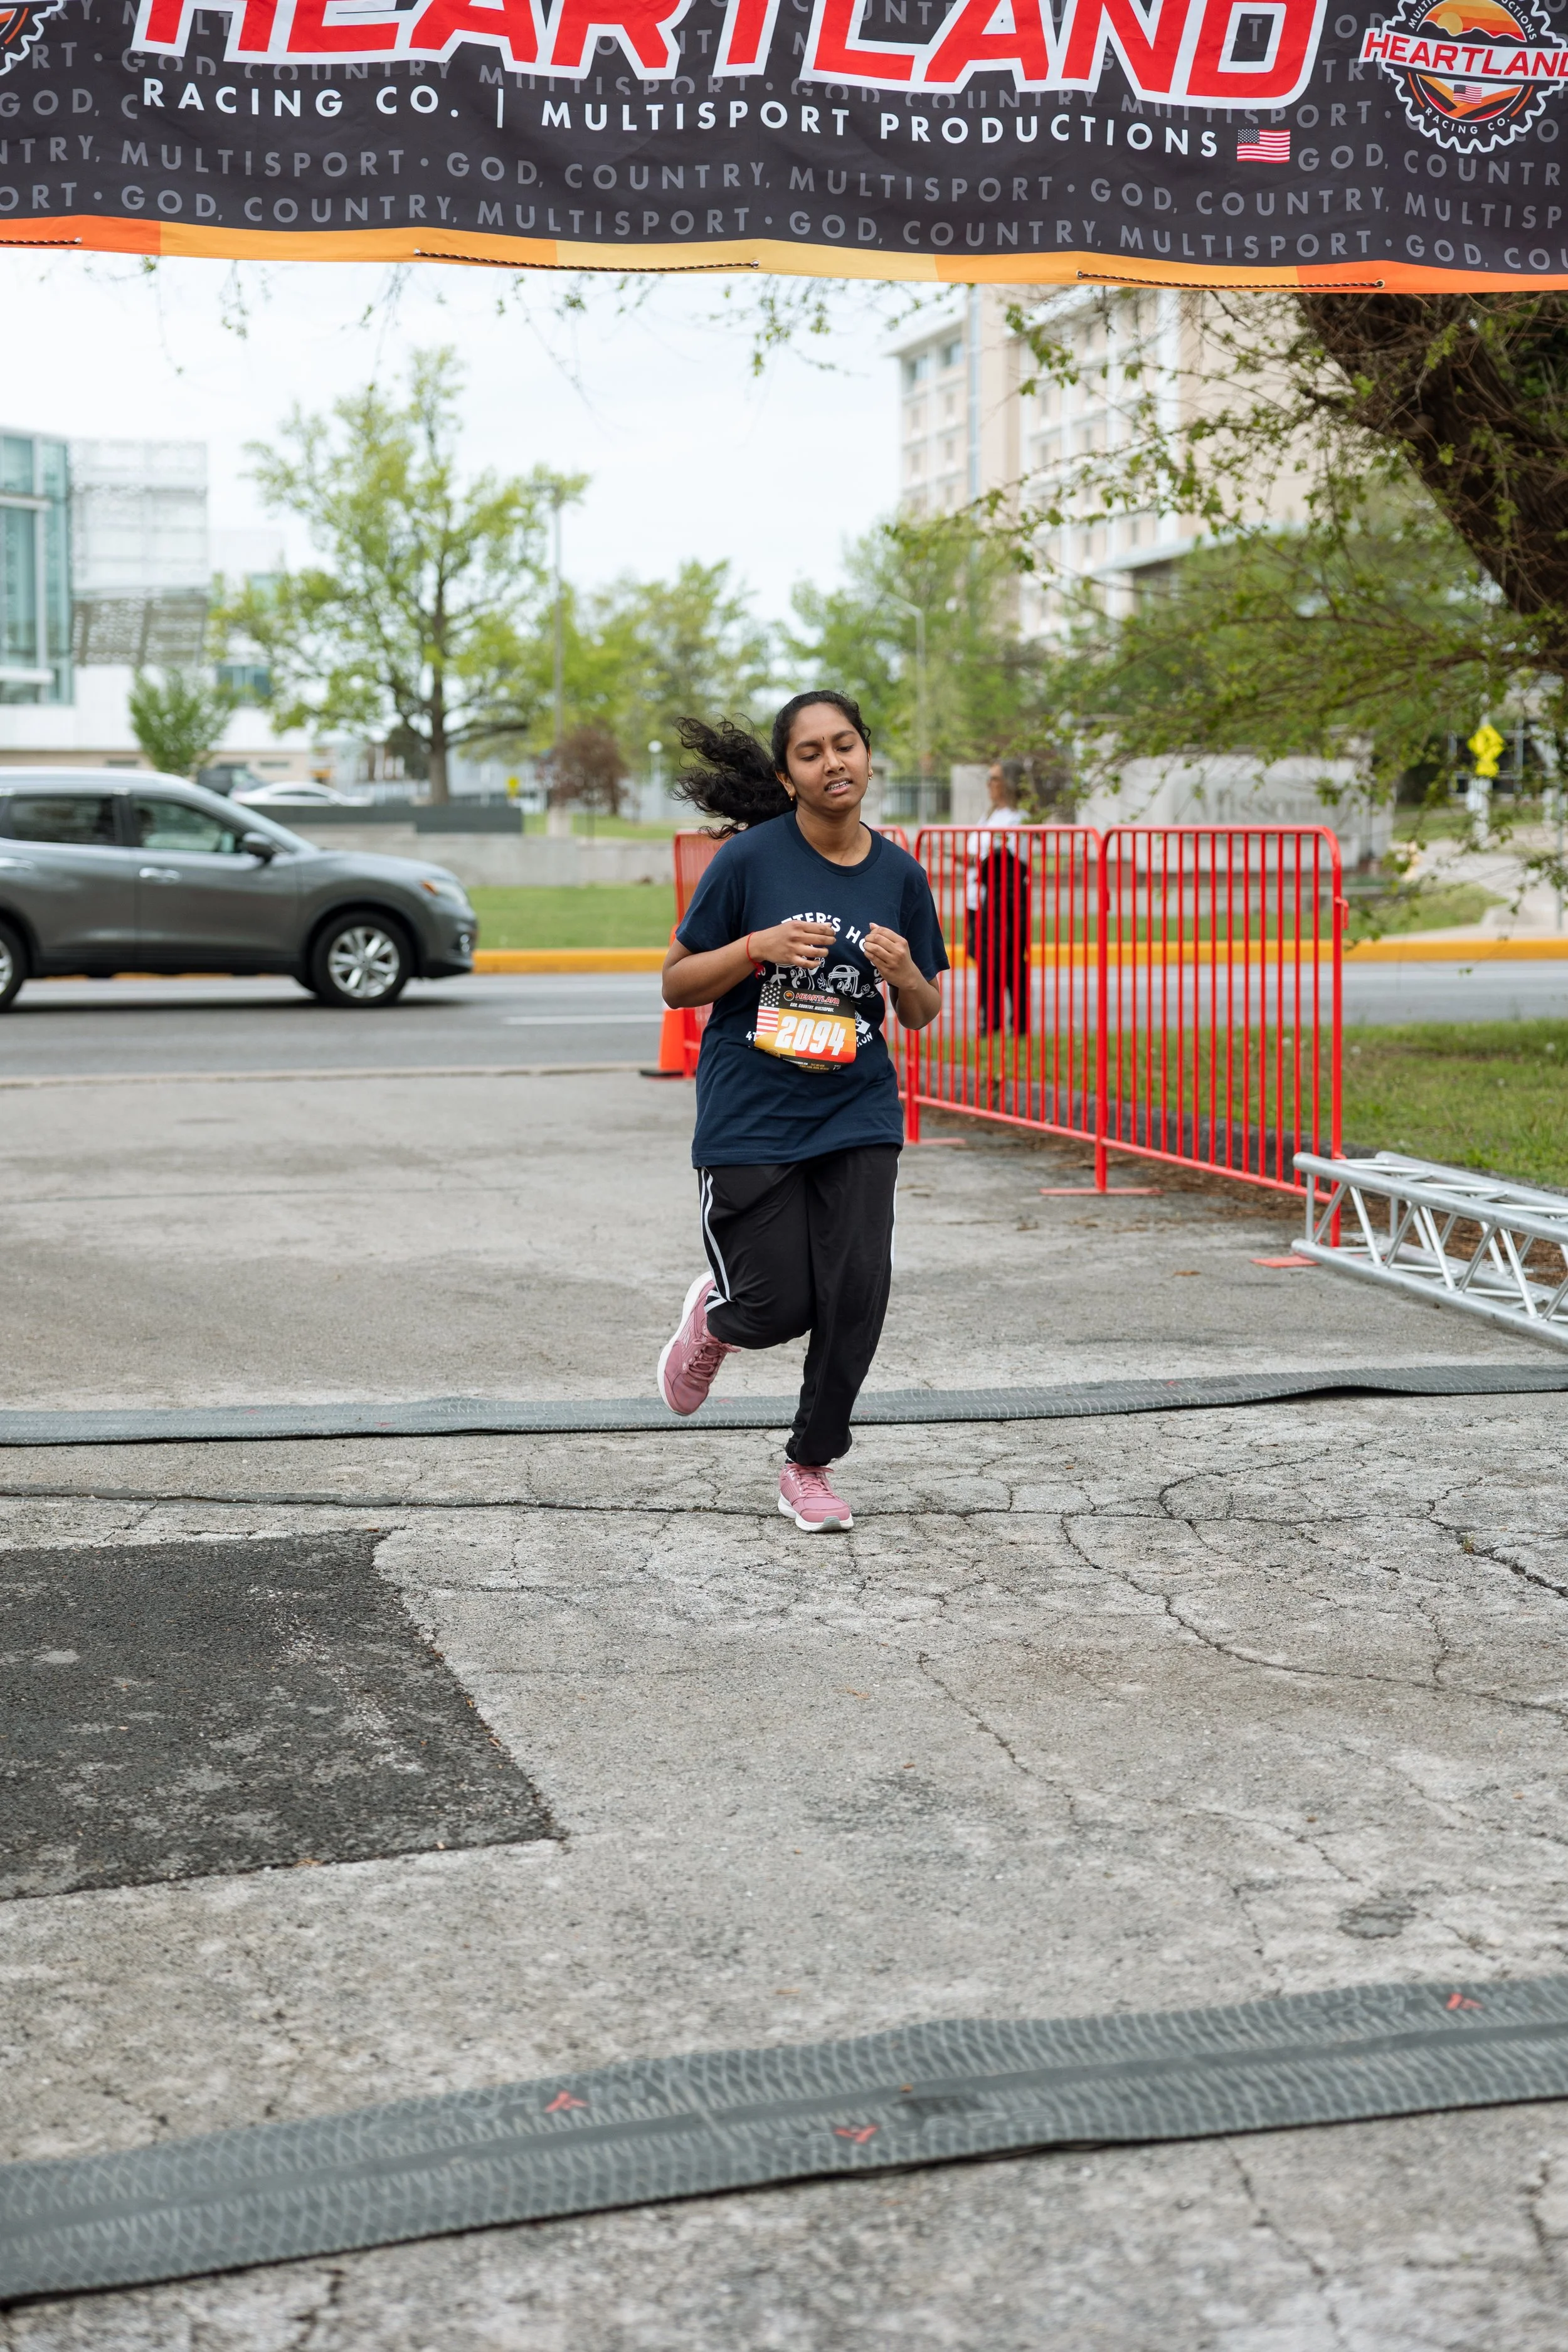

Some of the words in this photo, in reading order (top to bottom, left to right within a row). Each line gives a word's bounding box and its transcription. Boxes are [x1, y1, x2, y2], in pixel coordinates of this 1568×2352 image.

[144, 78, 342, 117] RACING
[376, 85, 458, 117] CO.
[542, 101, 849, 135] MULTISPORT
[881, 113, 1217, 157] PRODUCTIONS
[1426, 107, 1478, 135] RACING
[1488, 118, 1510, 131] CO.
[121, 140, 404, 176] MULTISPORT
[447, 152, 543, 188] GOD,
[565, 162, 770, 189] COUNTRY,
[790, 167, 1052, 201] MULTISPORT
[1091, 179, 1177, 213] GOD,
[1197, 187, 1389, 216] COUNTRY,
[1405, 193, 1561, 228] MULTISP
[1298, 144, 1388, 171] GOD,
[1404, 149, 1559, 185] COUNTR
[122, 189, 223, 220] GOD,
[244, 194, 457, 223] COUNTRY,
[477, 201, 749, 235] MULTISPORT
[790, 211, 882, 244] GOD,
[903, 220, 1101, 246] COUNTRY,
[1120, 225, 1370, 258] MULTISPORT
[1406, 235, 1488, 267] GOD,
[781, 912, 841, 933] ER'S
[795, 992, 840, 1005] HEARTLAND
[775, 1017, 846, 1056] 2094
